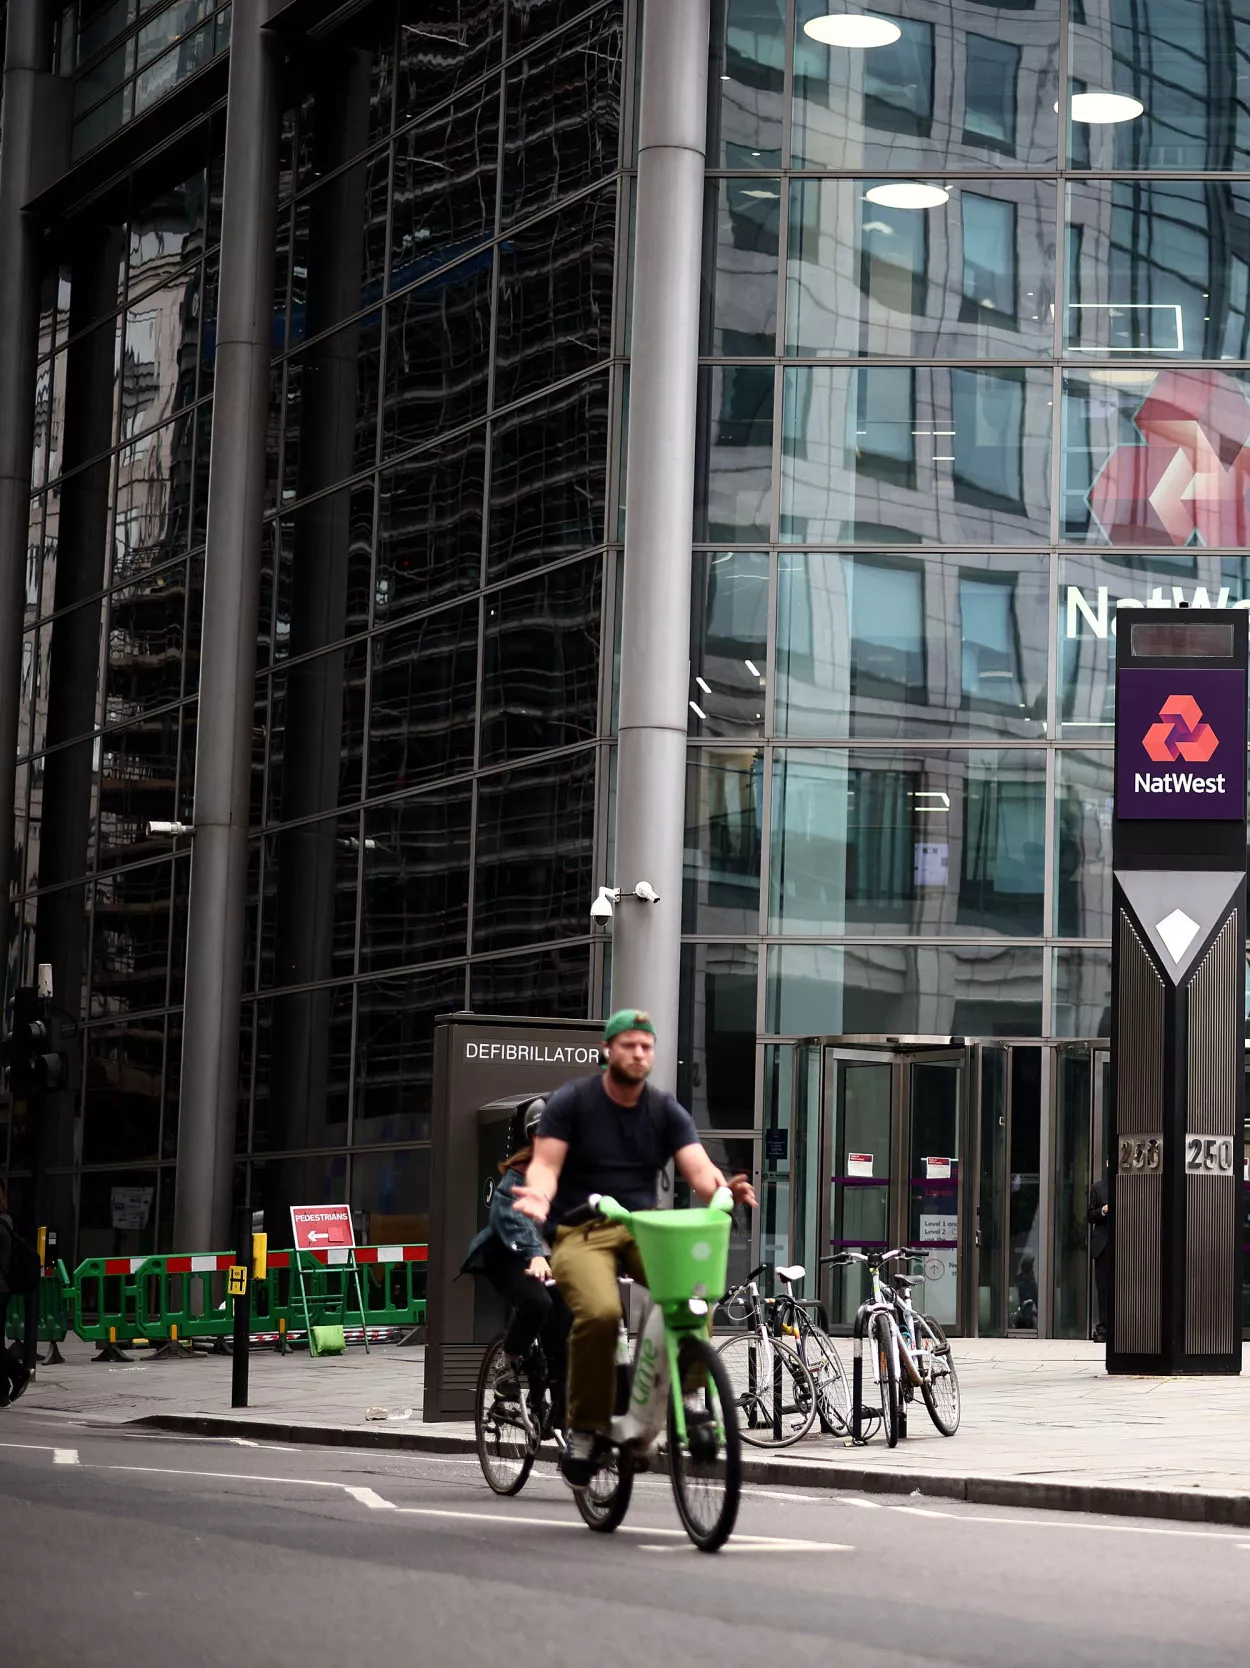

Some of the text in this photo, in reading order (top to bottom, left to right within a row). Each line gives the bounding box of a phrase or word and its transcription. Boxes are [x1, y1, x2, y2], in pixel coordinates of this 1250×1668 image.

[1134, 772, 1226, 794] NatWest
[466, 1042, 600, 1064] DEFIBRILLATOR
[1188, 1138, 1233, 1170] 250
[295, 1213, 348, 1223] PEDESTRIANS
